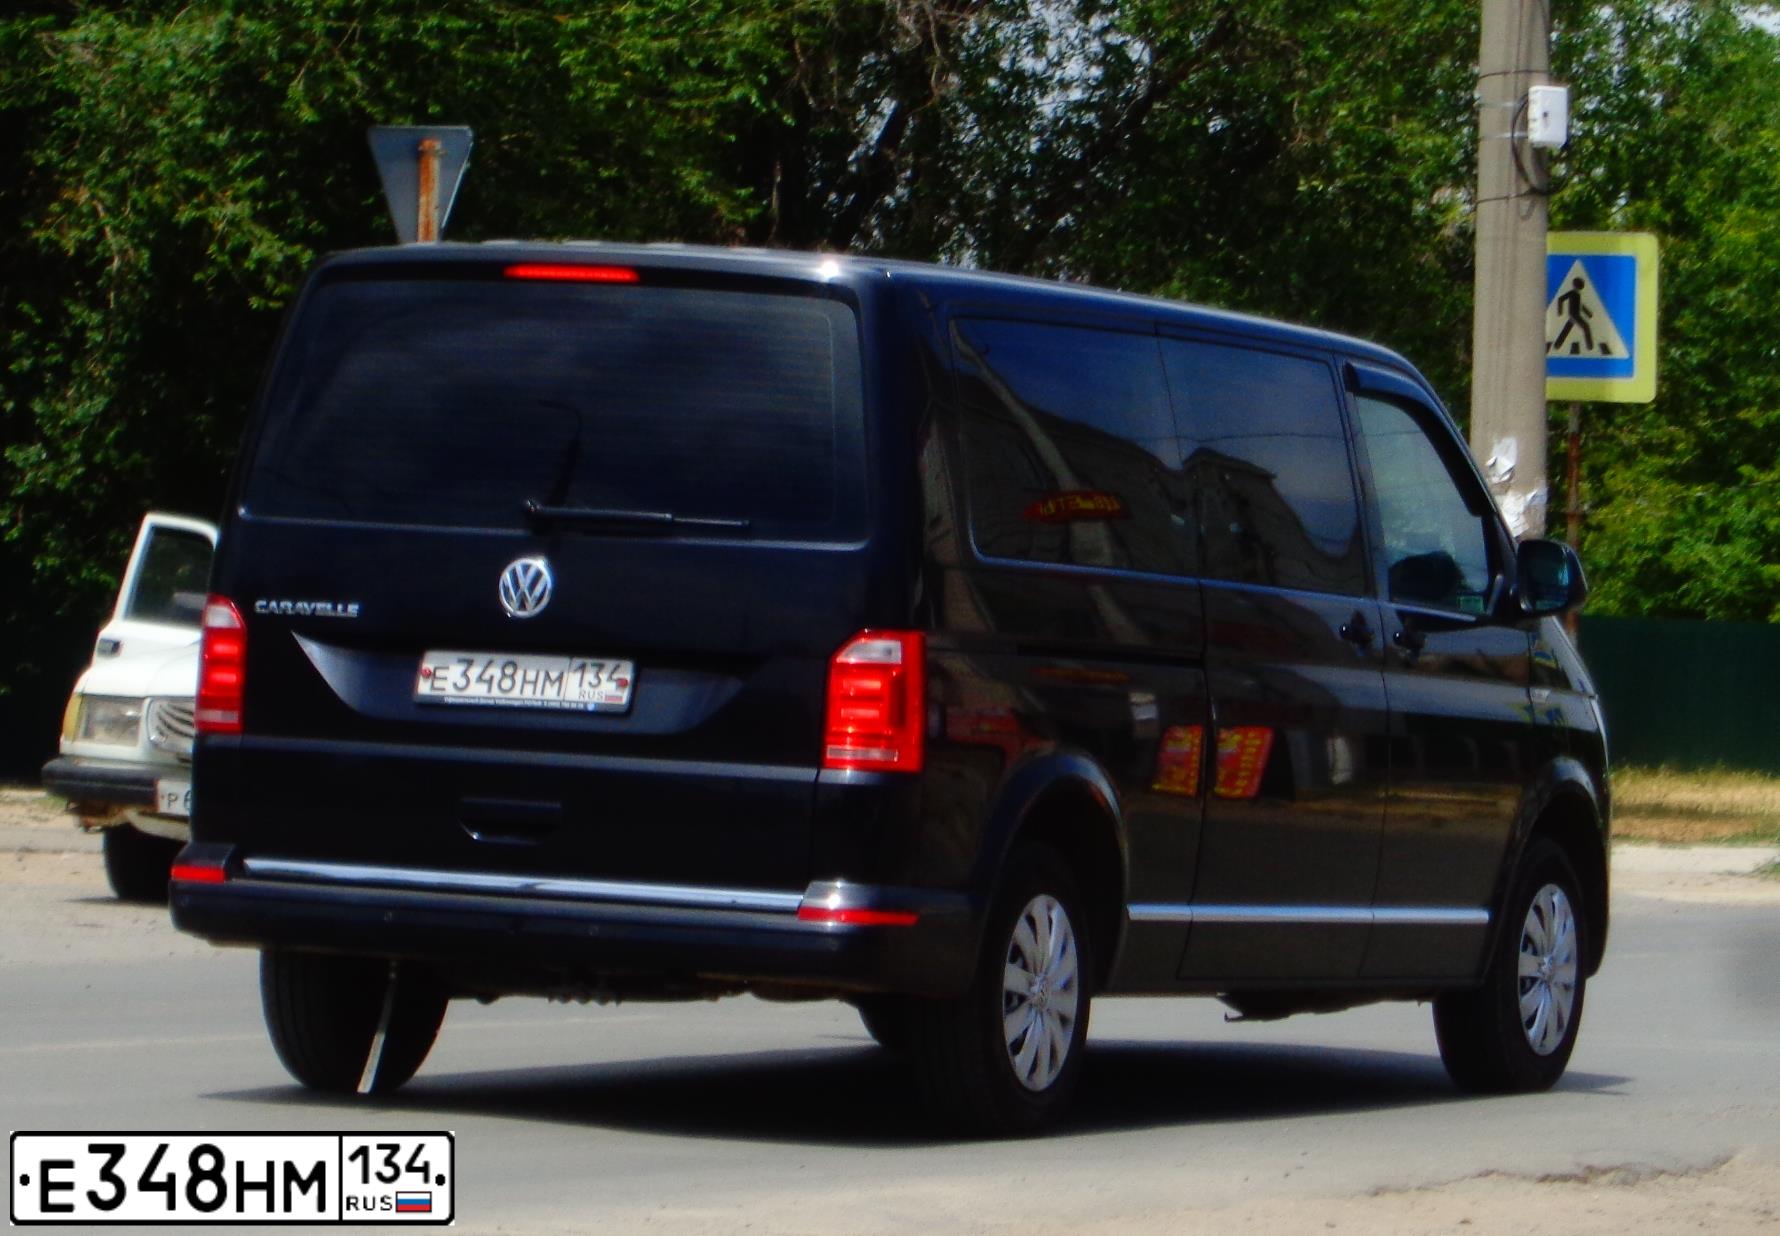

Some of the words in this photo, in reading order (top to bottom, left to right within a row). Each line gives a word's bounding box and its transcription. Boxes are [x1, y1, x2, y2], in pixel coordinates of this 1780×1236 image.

[254, 600, 359, 617] CARAVELLE
[430, 658, 564, 697] E348HM
[573, 661, 621, 690] 134
[578, 690, 604, 701] RUS
